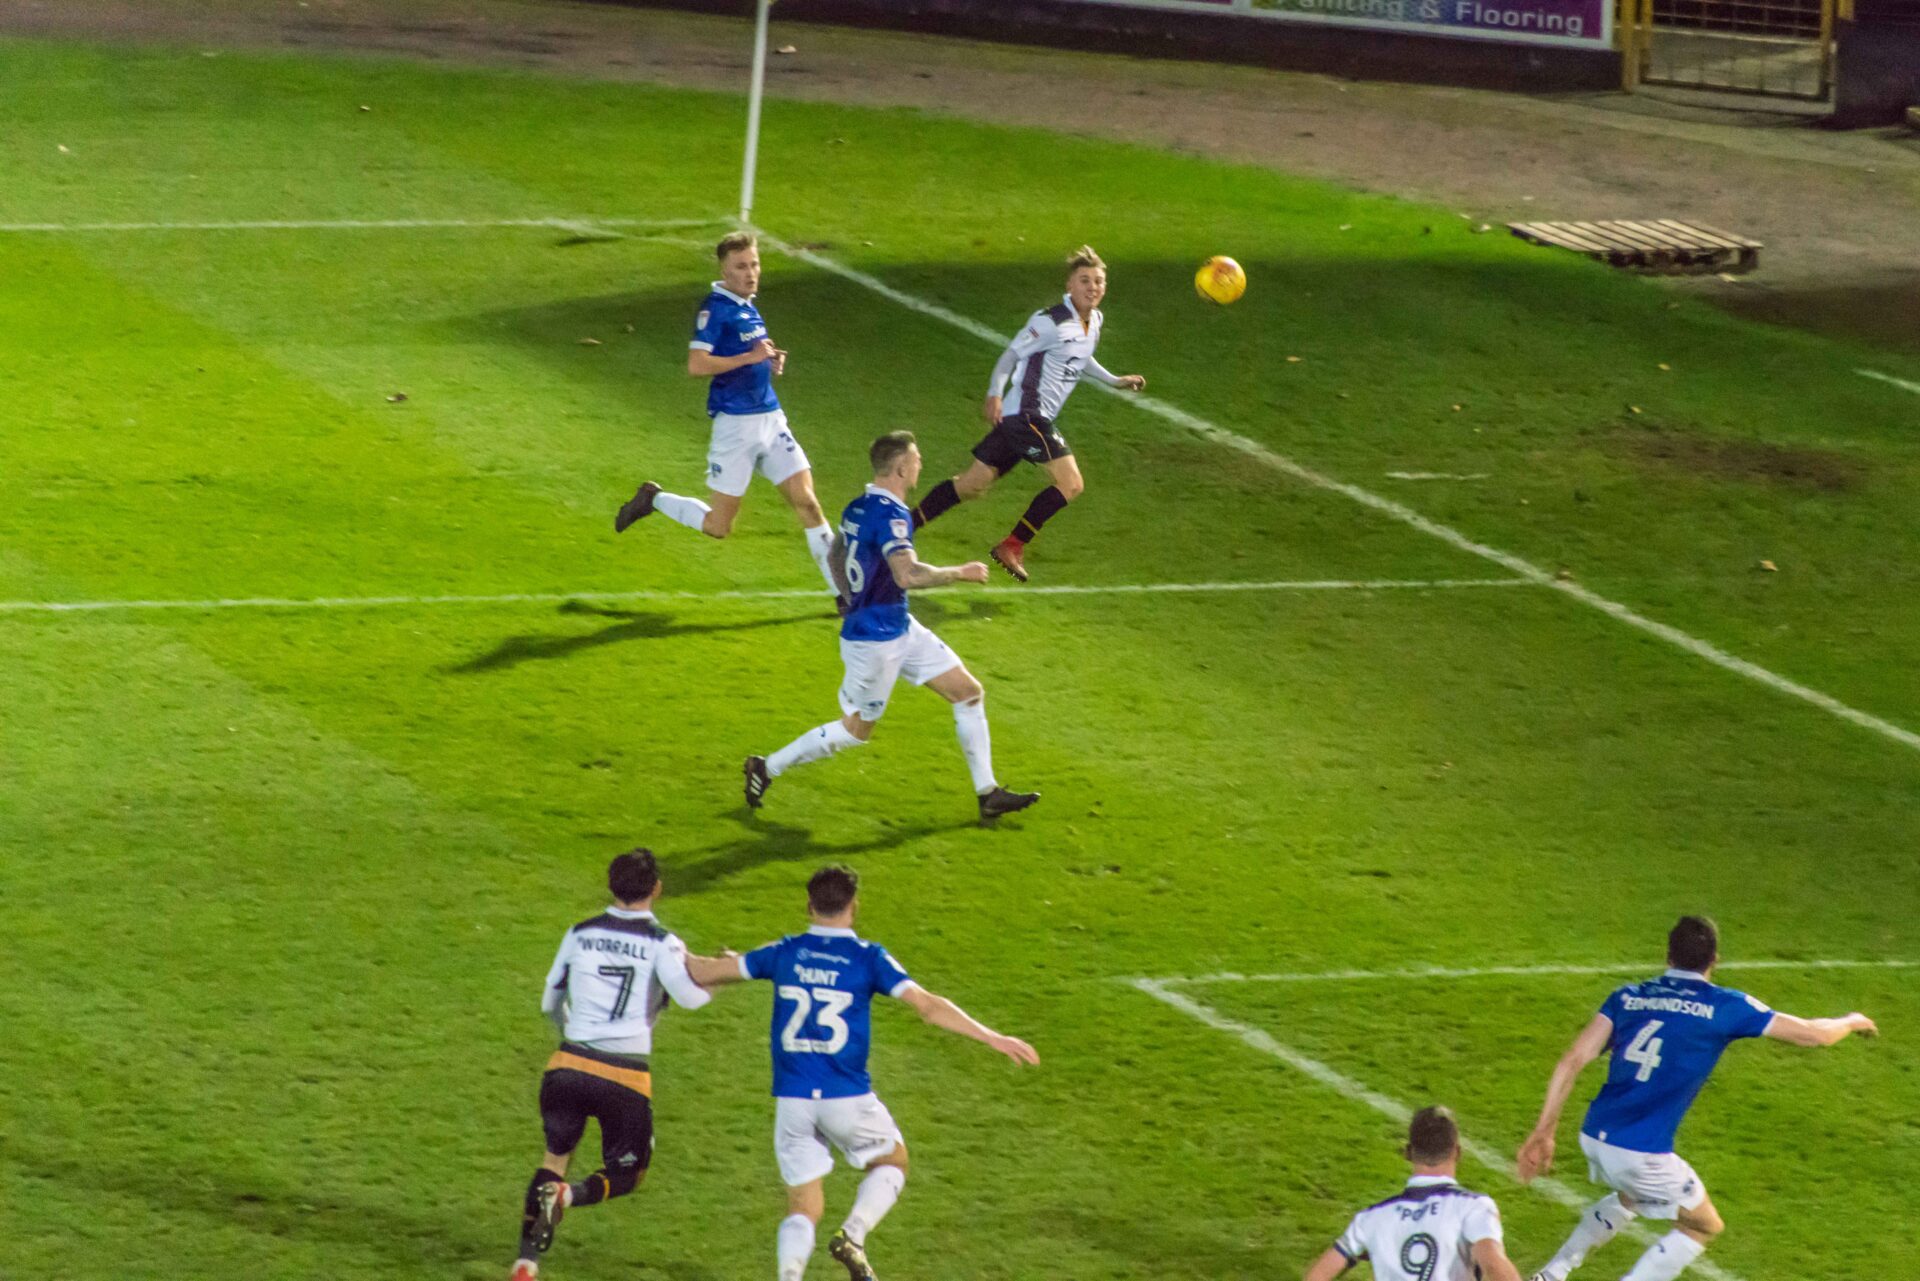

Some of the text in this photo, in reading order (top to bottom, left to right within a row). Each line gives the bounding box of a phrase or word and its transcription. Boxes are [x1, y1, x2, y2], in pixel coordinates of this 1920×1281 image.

[1279, 0, 1583, 37] ainting & Flooring
[580, 938, 648, 961] WORRALL
[598, 965, 635, 1022] 7
[798, 966, 840, 986] HUNT
[778, 985, 854, 1055] 23
[1623, 996, 1715, 1020] EDMUNDSON
[1624, 1019, 1664, 1082] 4
[1401, 1232, 1438, 1281] 9
